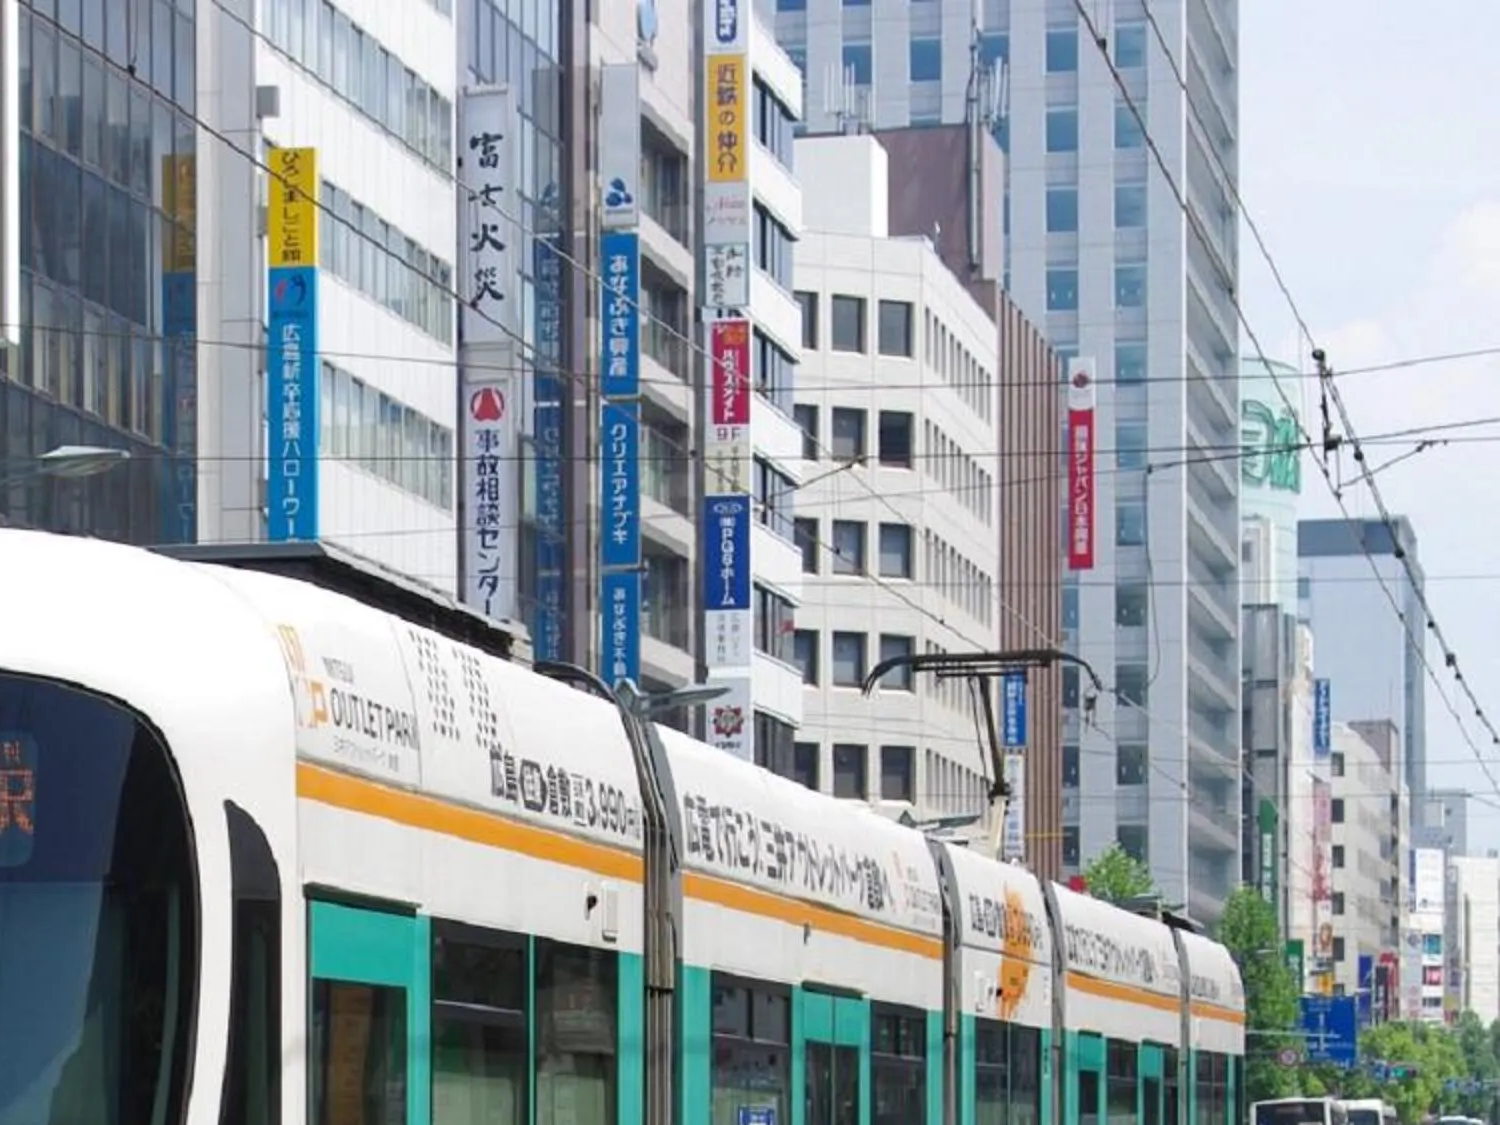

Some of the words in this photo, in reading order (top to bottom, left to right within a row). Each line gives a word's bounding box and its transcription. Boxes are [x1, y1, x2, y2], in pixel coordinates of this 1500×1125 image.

[282, 324, 301, 542] 広島新卒応援ハローワー
[475, 429, 501, 616] 事故相談センター
